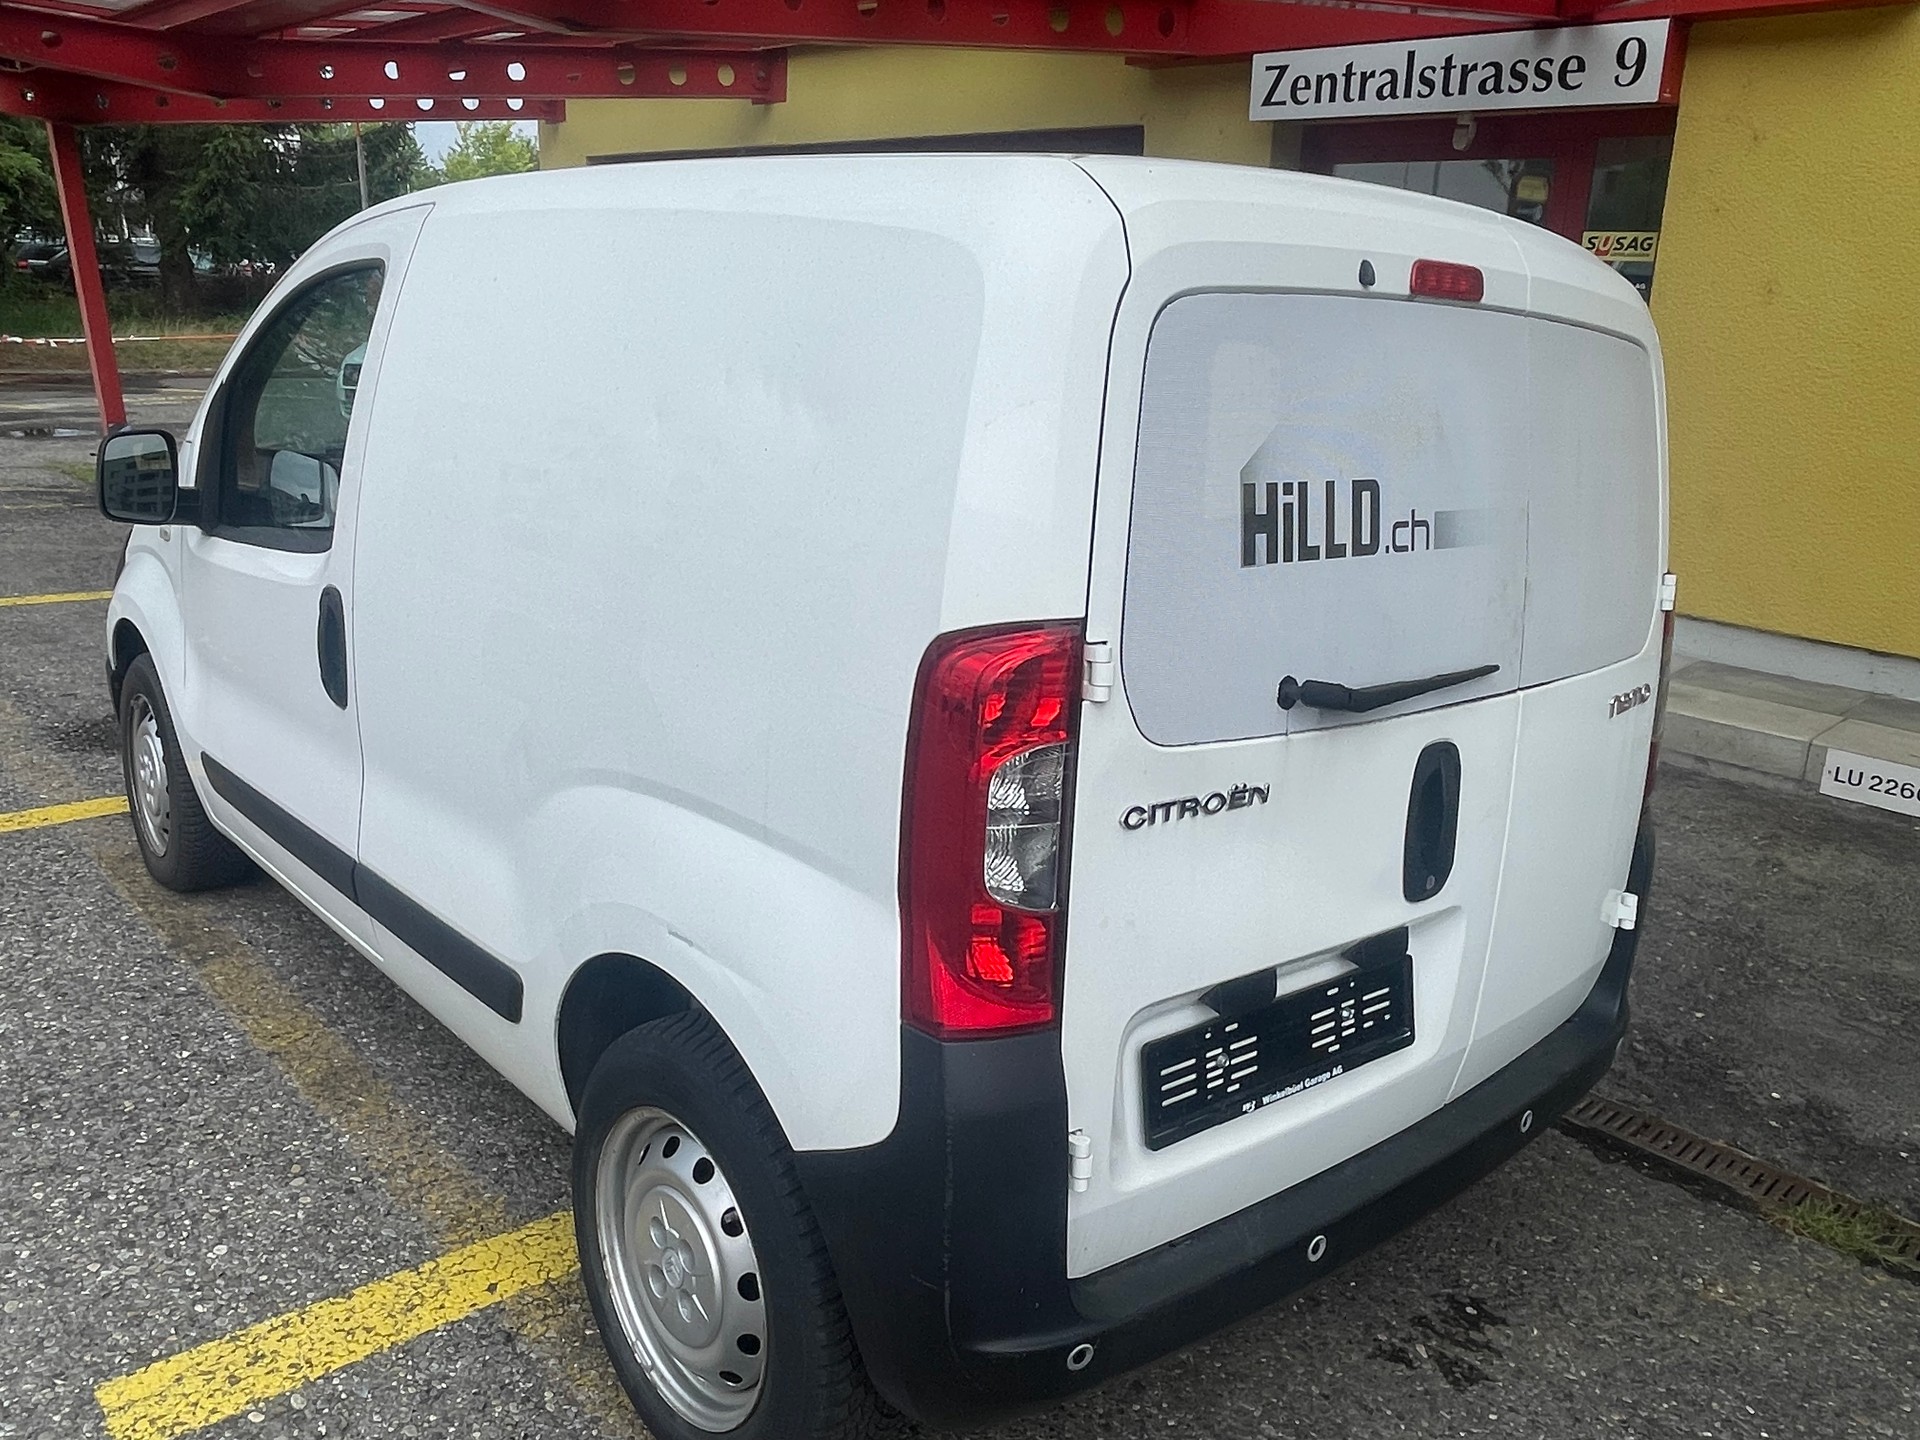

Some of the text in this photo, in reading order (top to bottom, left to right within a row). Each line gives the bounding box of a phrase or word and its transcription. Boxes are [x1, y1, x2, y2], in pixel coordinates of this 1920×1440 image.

[1261, 36, 1647, 107] Zentralstrasse 9
[1585, 235, 1654, 256] SUSAG
[1833, 766, 1920, 802] LU 226
[1119, 783, 1270, 830] CITROËN
[1304, 1071, 1331, 1088] Garage
[1332, 1065, 1343, 1077] AG
